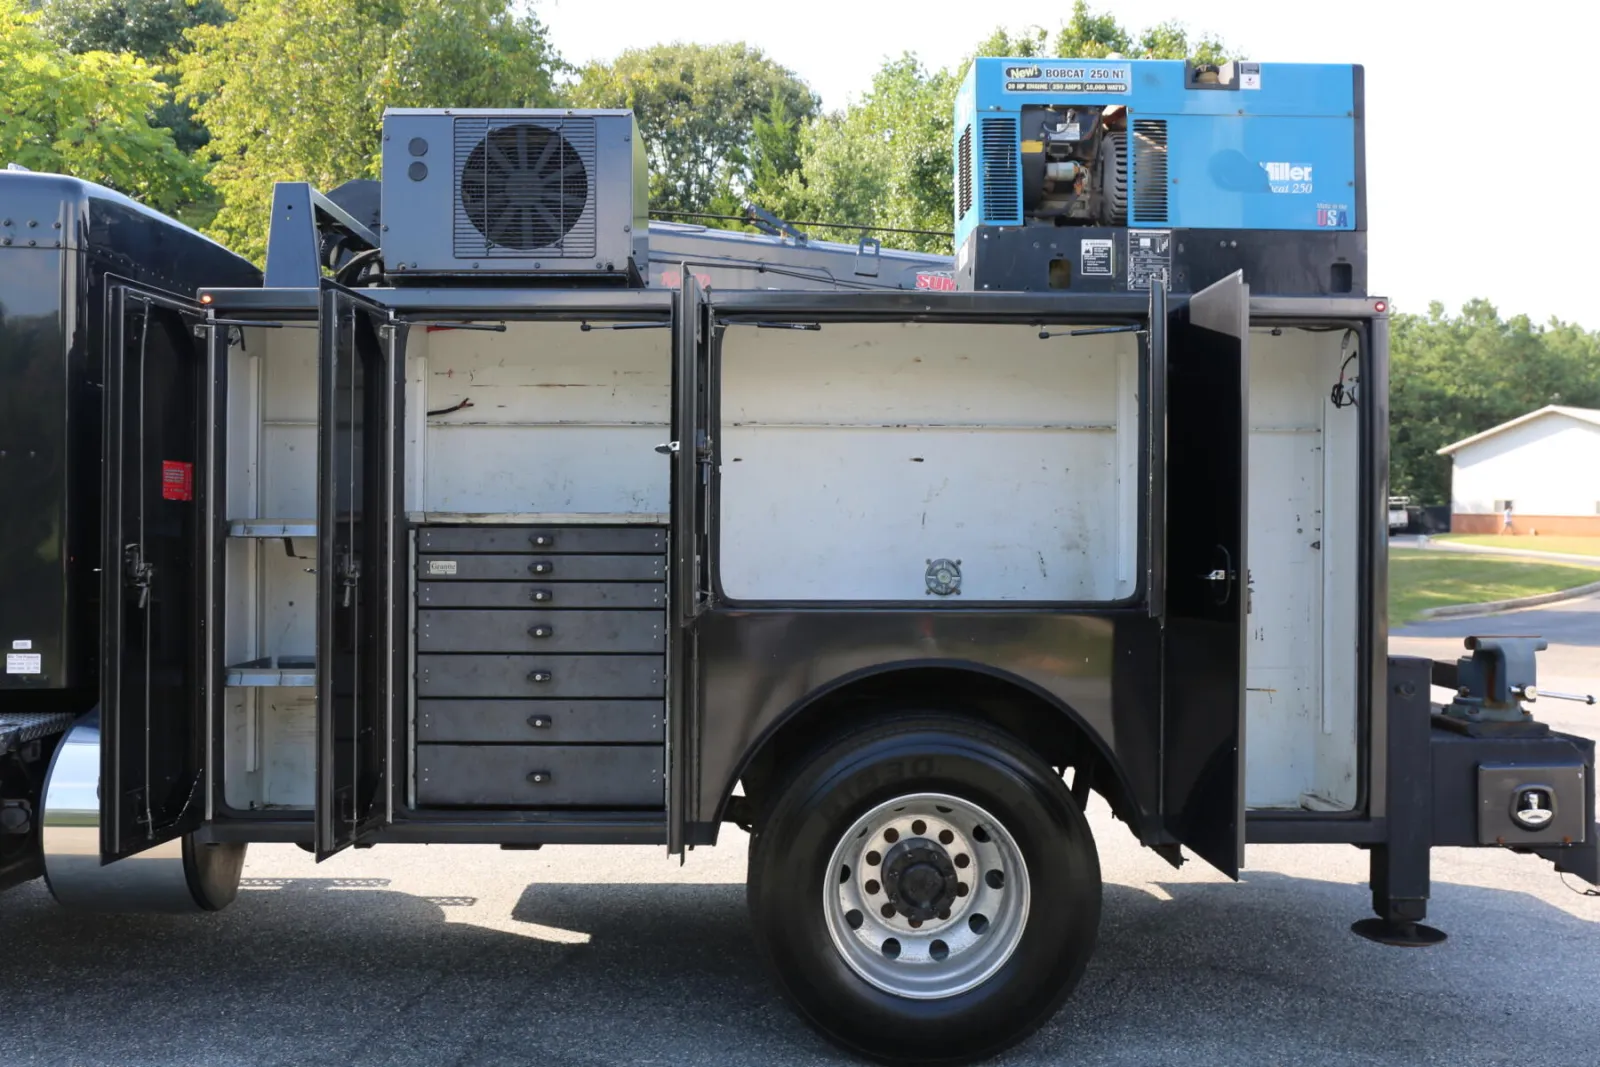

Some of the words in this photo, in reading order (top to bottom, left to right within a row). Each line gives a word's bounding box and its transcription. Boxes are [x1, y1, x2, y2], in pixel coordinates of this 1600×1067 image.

[1010, 65, 1038, 79] New!
[1045, 69, 1085, 78] BOBCAT
[1090, 69, 1109, 79] 250
[1112, 69, 1125, 79] NT
[1064, 83, 1082, 91] AMPS
[1106, 84, 1126, 92] WATTS
[1292, 183, 1312, 194] 250
[1316, 209, 1348, 227] USA
